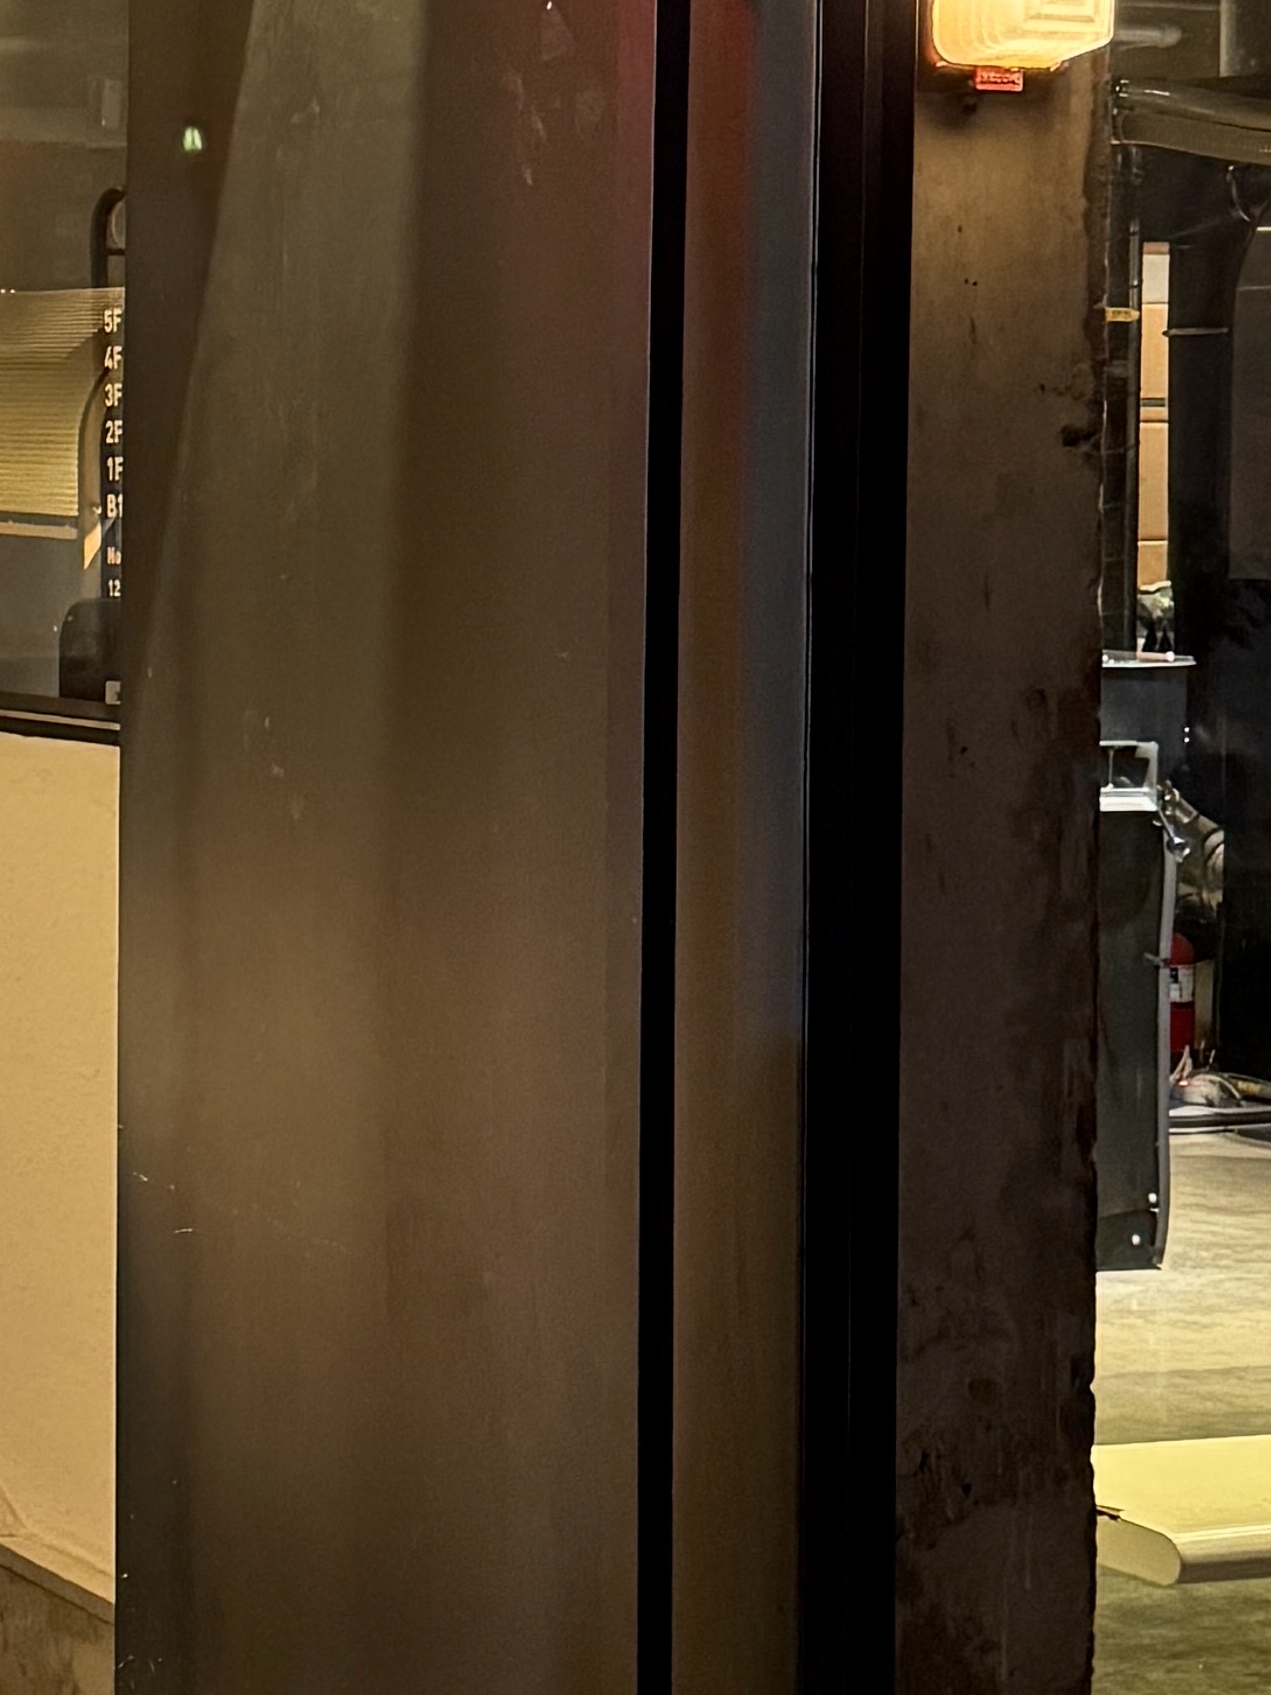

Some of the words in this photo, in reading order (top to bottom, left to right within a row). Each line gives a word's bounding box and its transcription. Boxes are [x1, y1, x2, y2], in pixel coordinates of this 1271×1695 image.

[103, 307, 123, 334] 5F
[104, 345, 123, 370] 4F
[104, 383, 123, 407] 3F
[105, 419, 123, 444] 2F
[106, 456, 124, 481] 1F
[106, 493, 123, 518] B1
